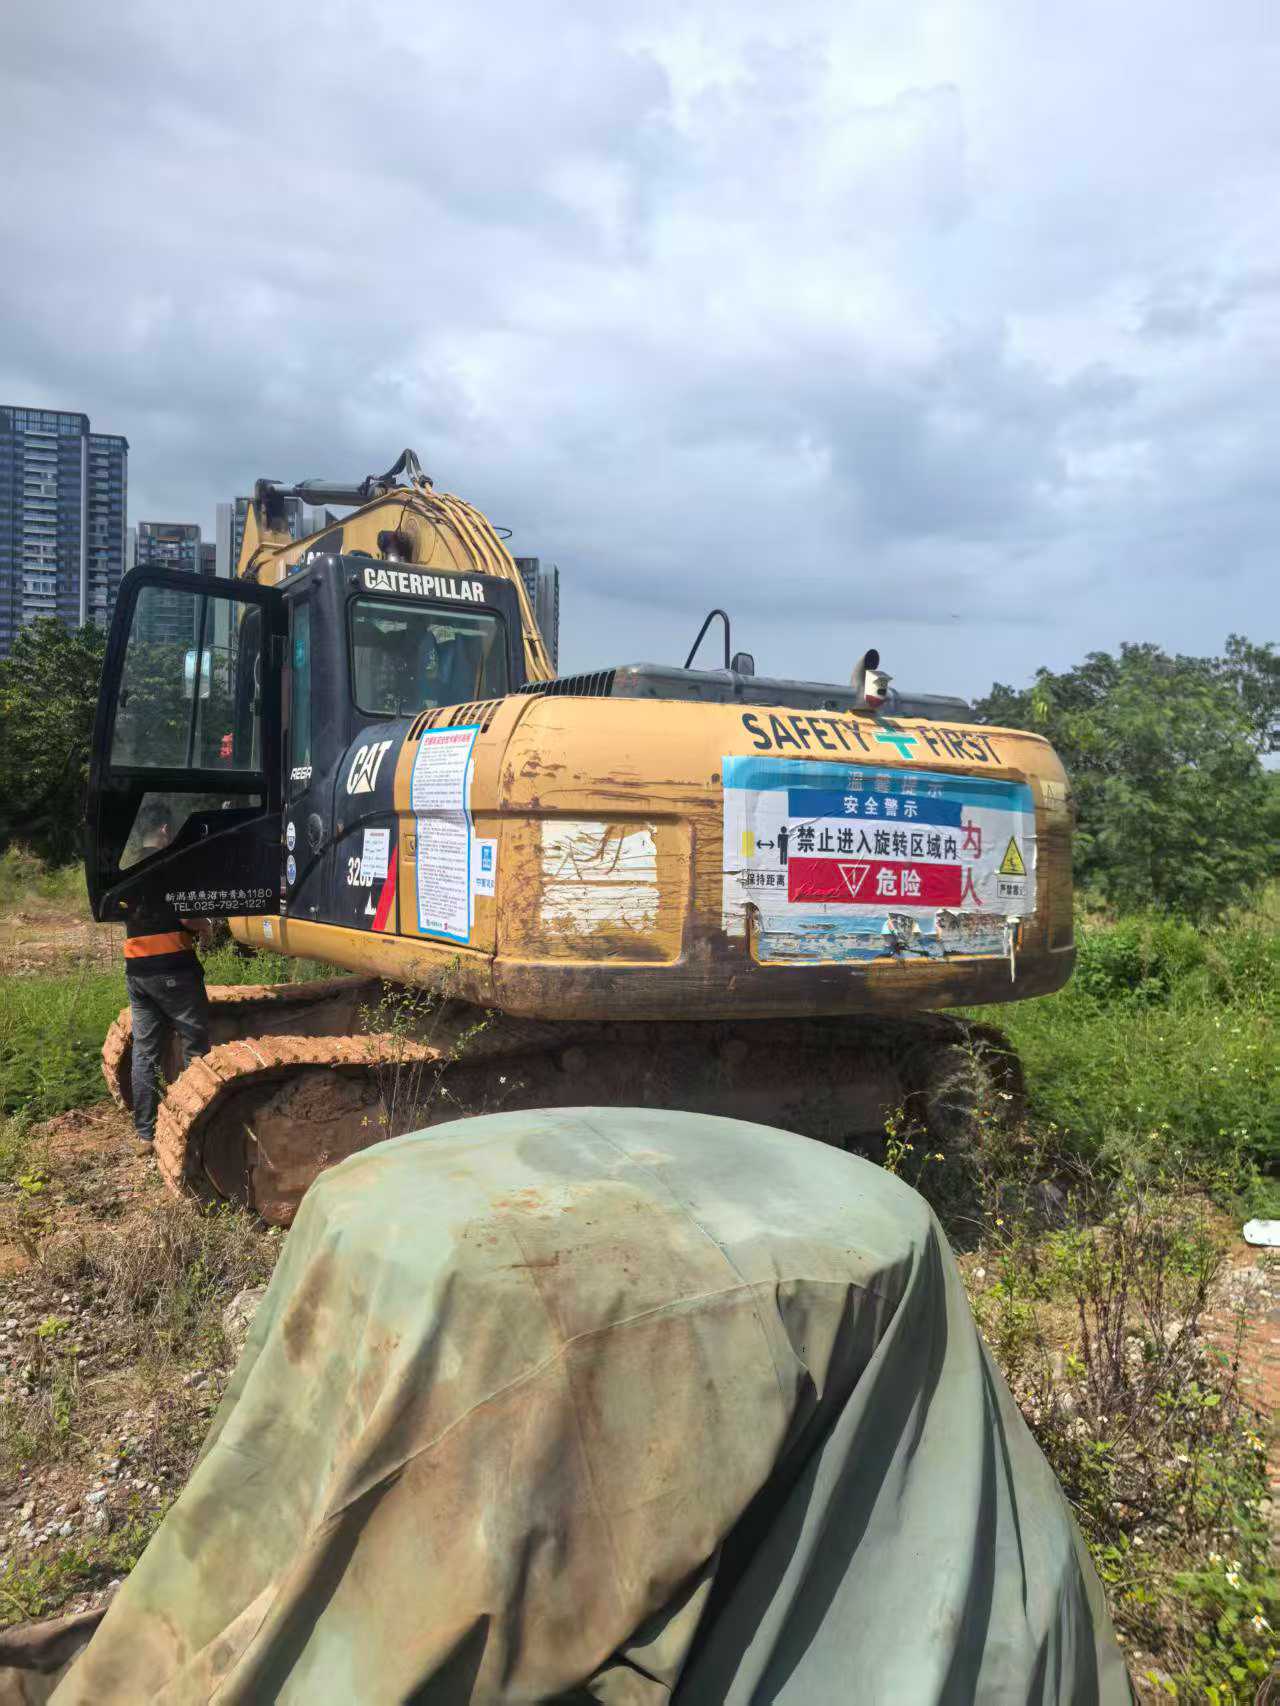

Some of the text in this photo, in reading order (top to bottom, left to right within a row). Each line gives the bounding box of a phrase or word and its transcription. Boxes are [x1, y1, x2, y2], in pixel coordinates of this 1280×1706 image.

[364, 568, 486, 603] CATERPILLAR
[742, 712, 1002, 765] SAFETY FIRST
[346, 740, 393, 794] CAT
[843, 795, 919, 819] 安全警示
[797, 825, 959, 860] 禁止进入旋转区域内
[347, 857, 374, 887] 32
[747, 873, 785, 887] 保持距离
[875, 867, 923, 897] 危险
